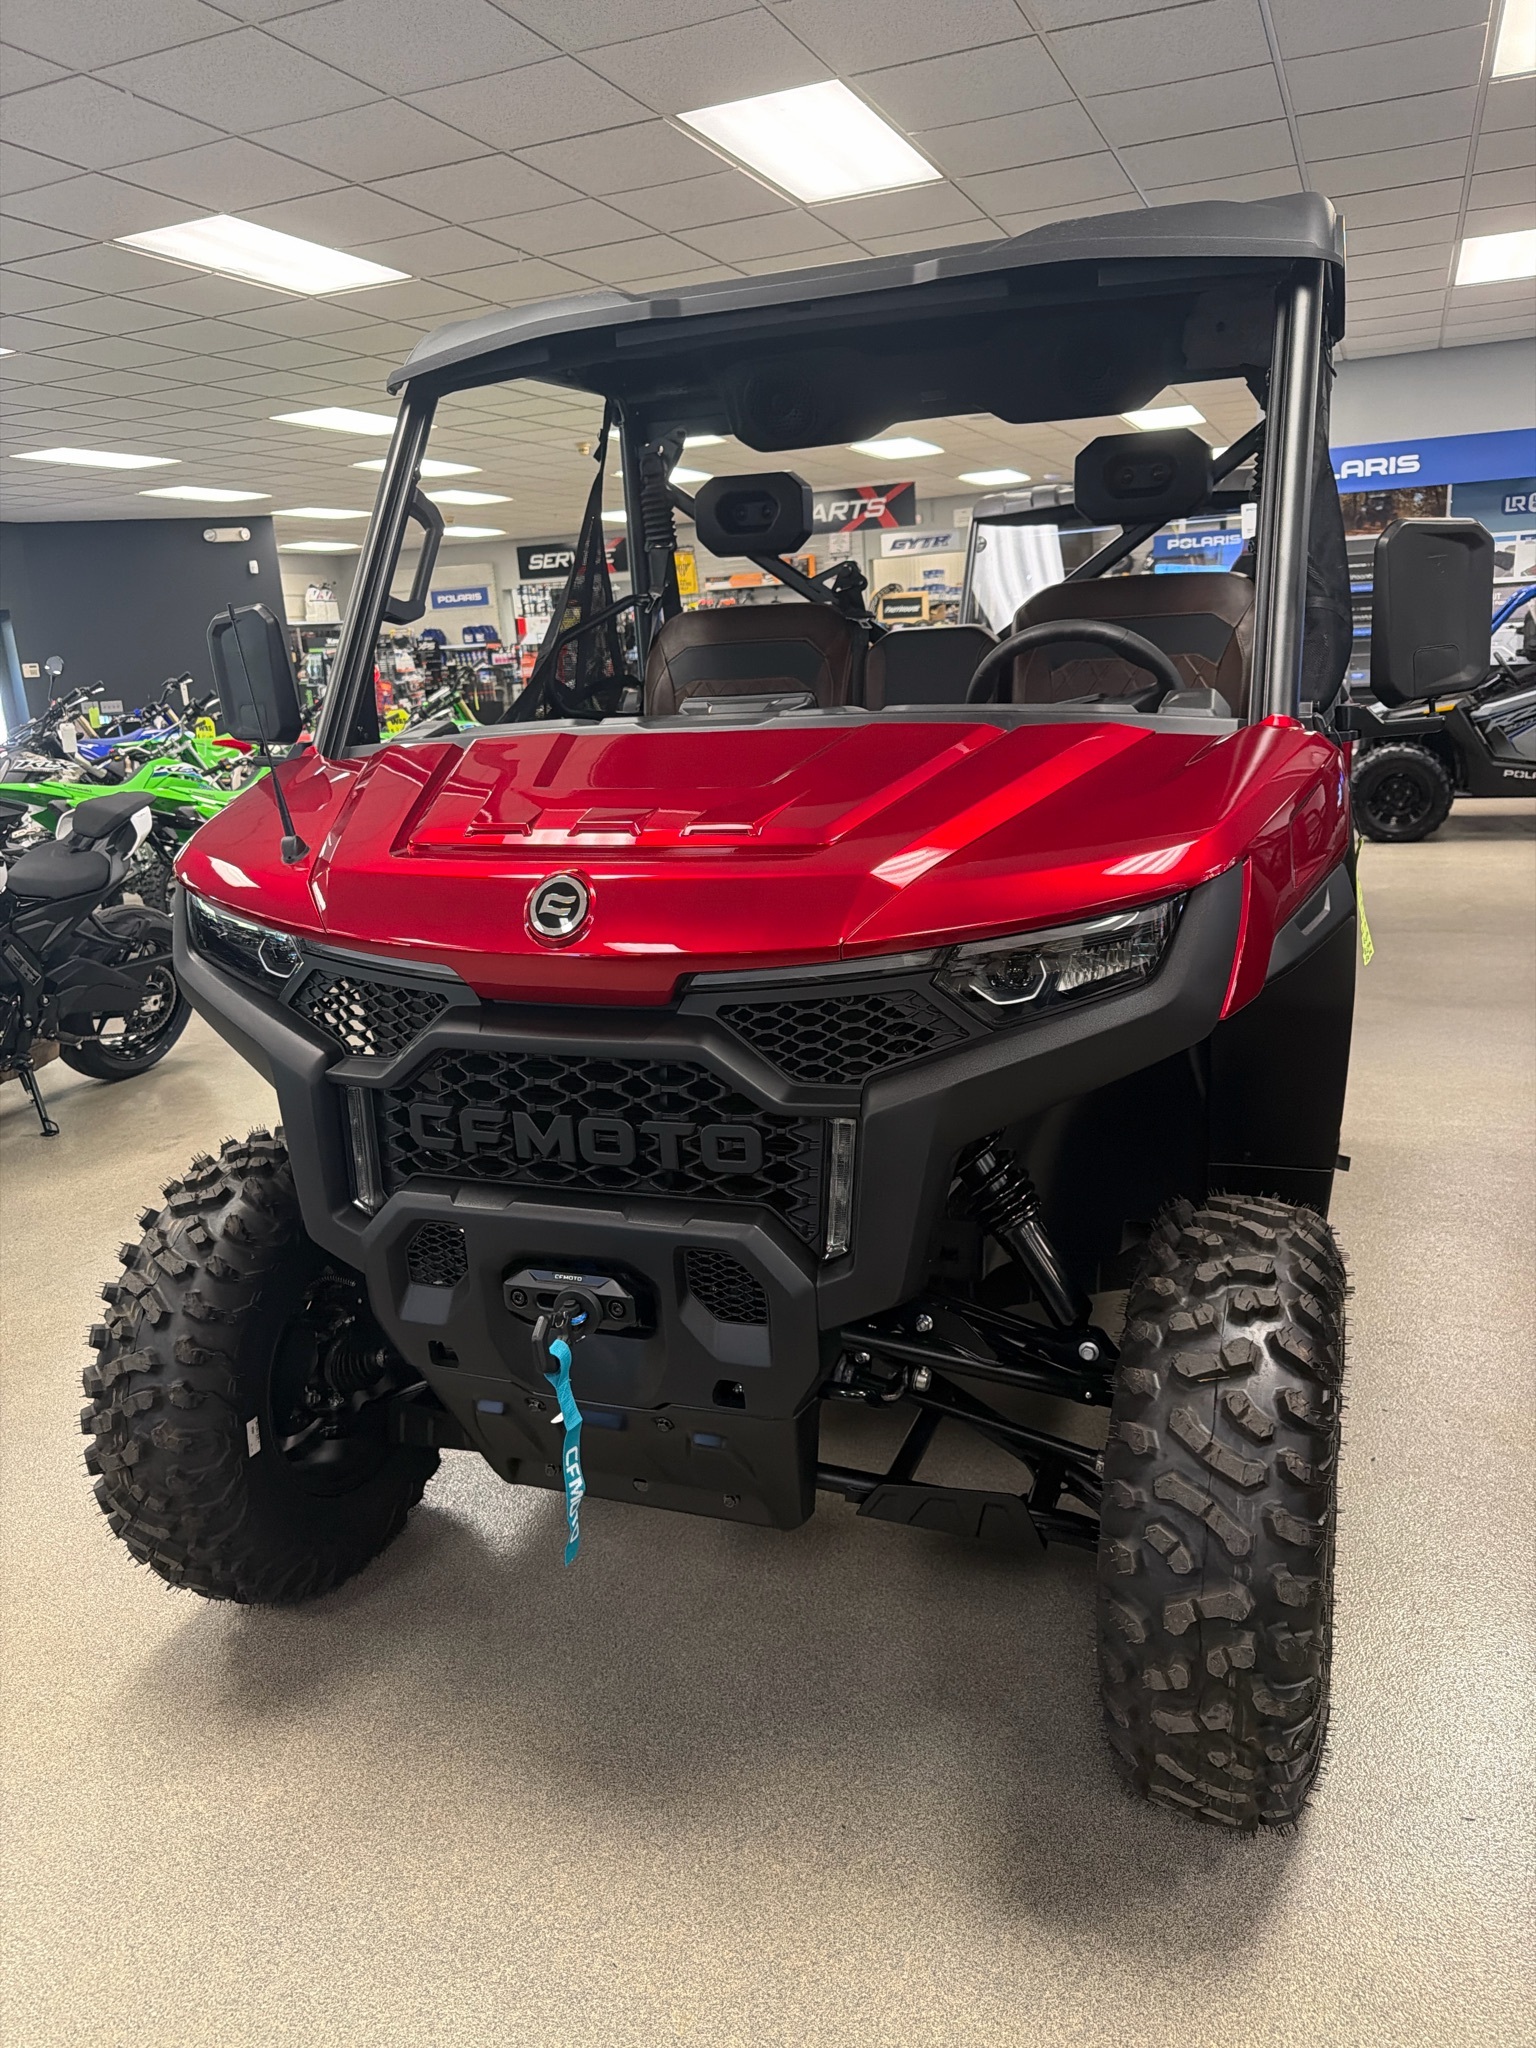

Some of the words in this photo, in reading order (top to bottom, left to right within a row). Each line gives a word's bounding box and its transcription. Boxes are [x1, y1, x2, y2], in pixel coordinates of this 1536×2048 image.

[1334, 454, 1421, 479] ARIS
[813, 497, 887, 523] ARTS
[889, 534, 952, 551] GYTR
[1167, 534, 1241, 550] POLARIS
[437, 592, 483, 605] POLARIS
[408, 1102, 763, 1175] CFMOTO
[554, 1273, 583, 1282] CFMOTO
